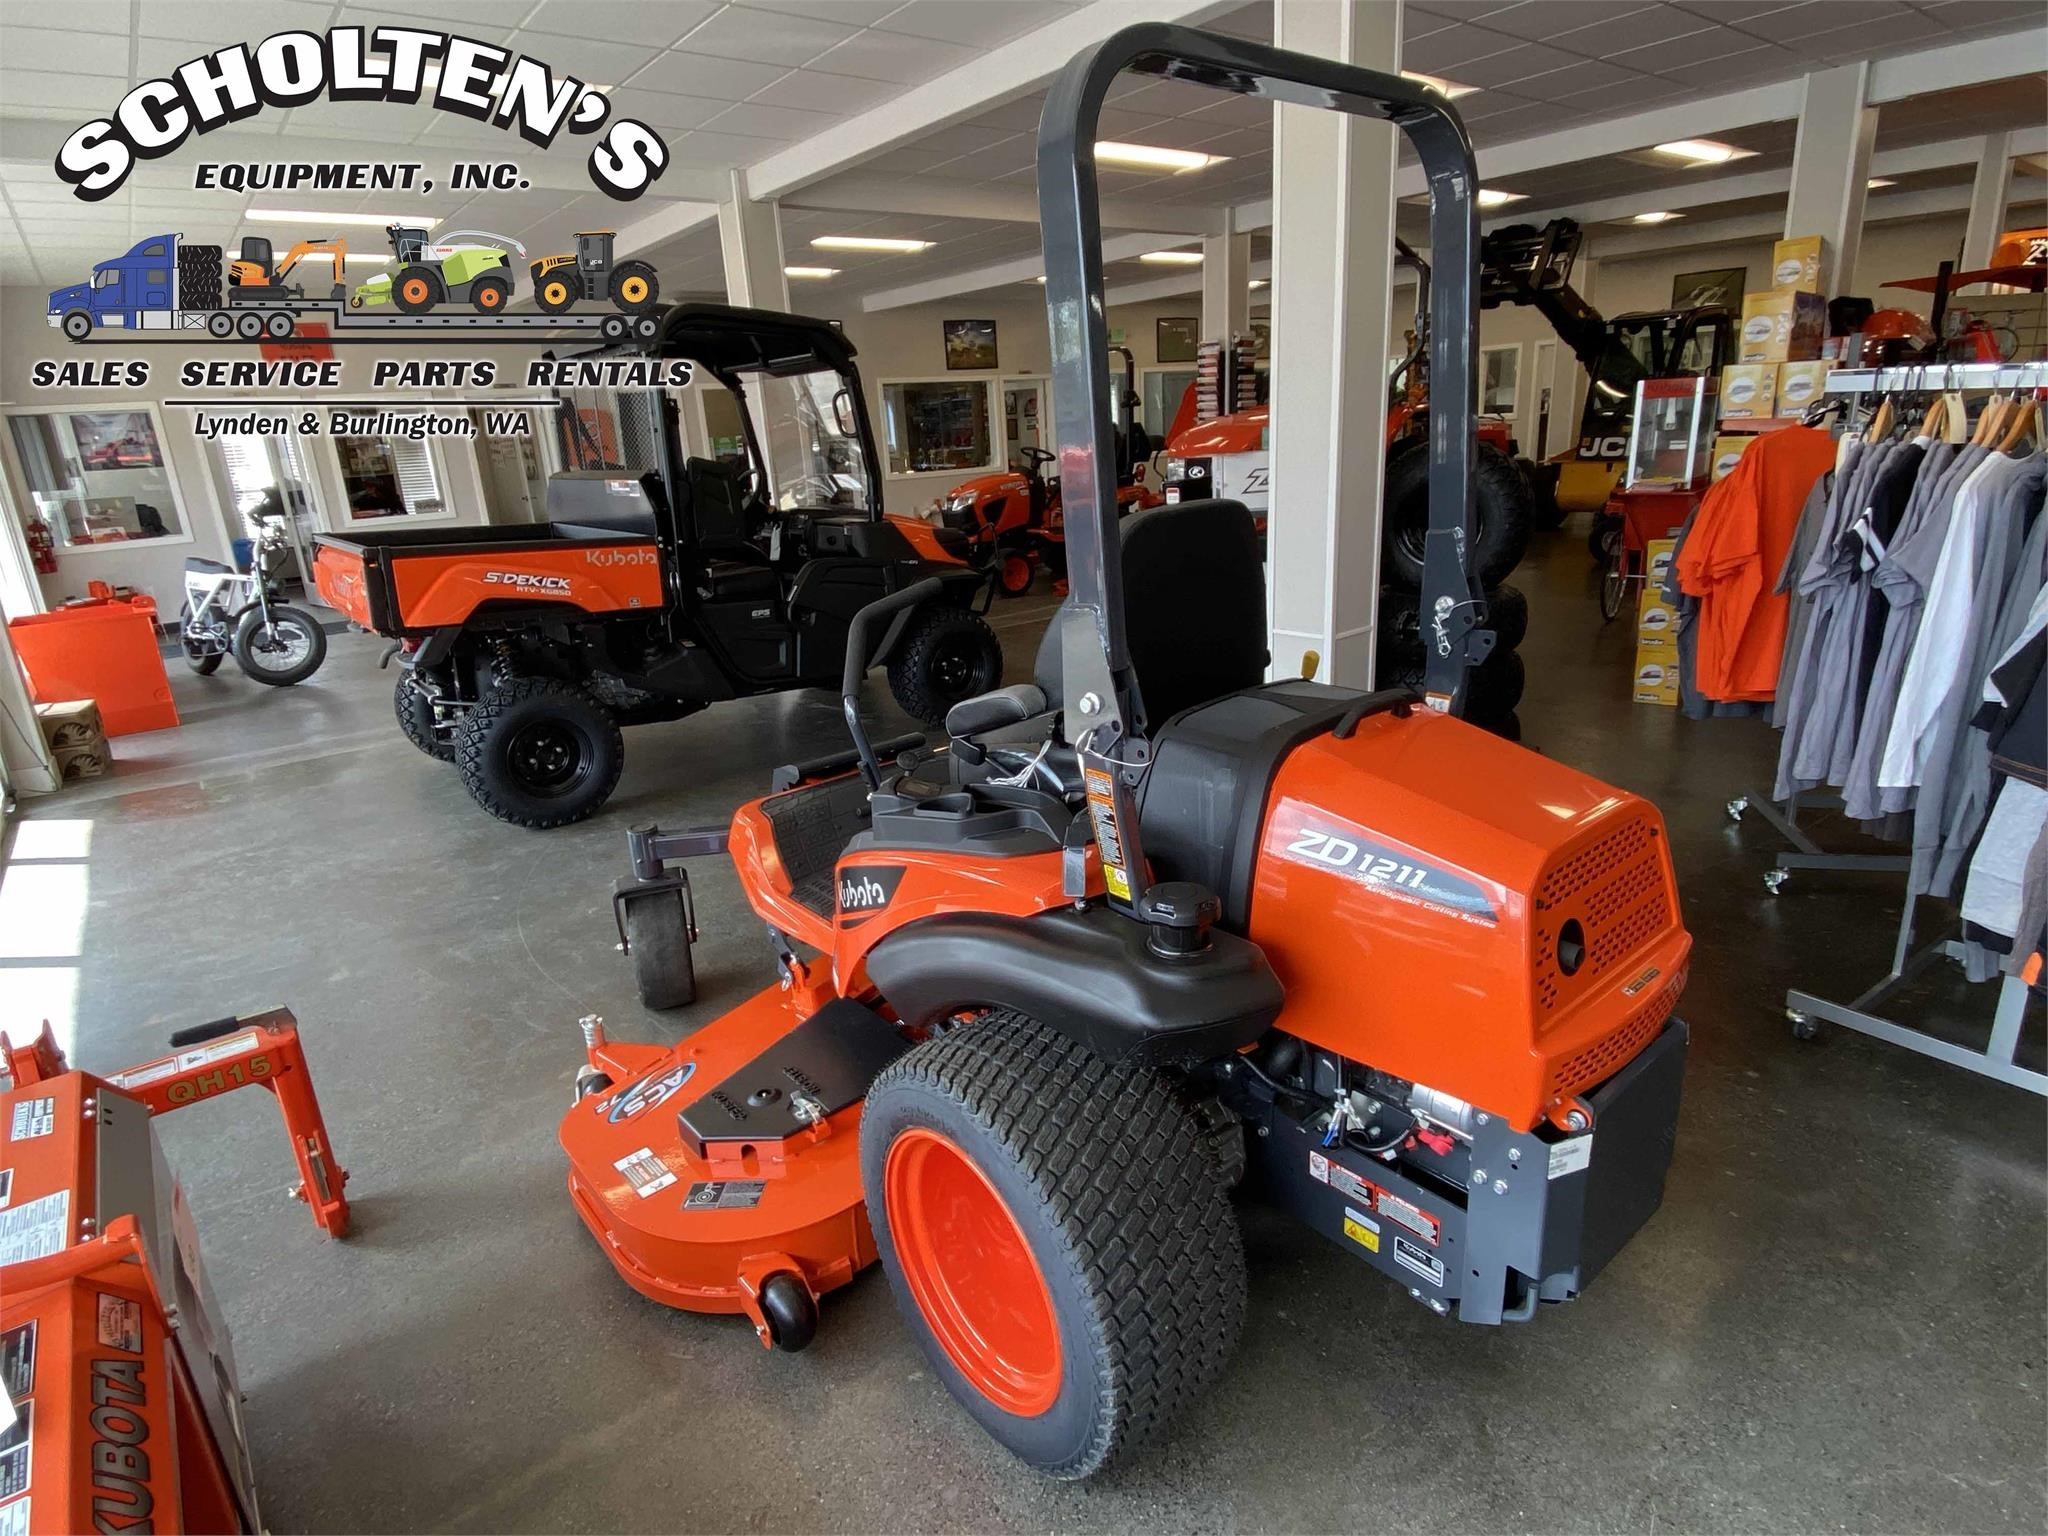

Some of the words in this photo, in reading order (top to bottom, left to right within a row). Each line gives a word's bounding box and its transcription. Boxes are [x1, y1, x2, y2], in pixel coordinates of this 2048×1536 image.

[586, 549, 657, 567] Kubota
[483, 572, 571, 589] SIDEKICK
[838, 876, 885, 907] Kubota
[622, 1069, 684, 1118] ACS
